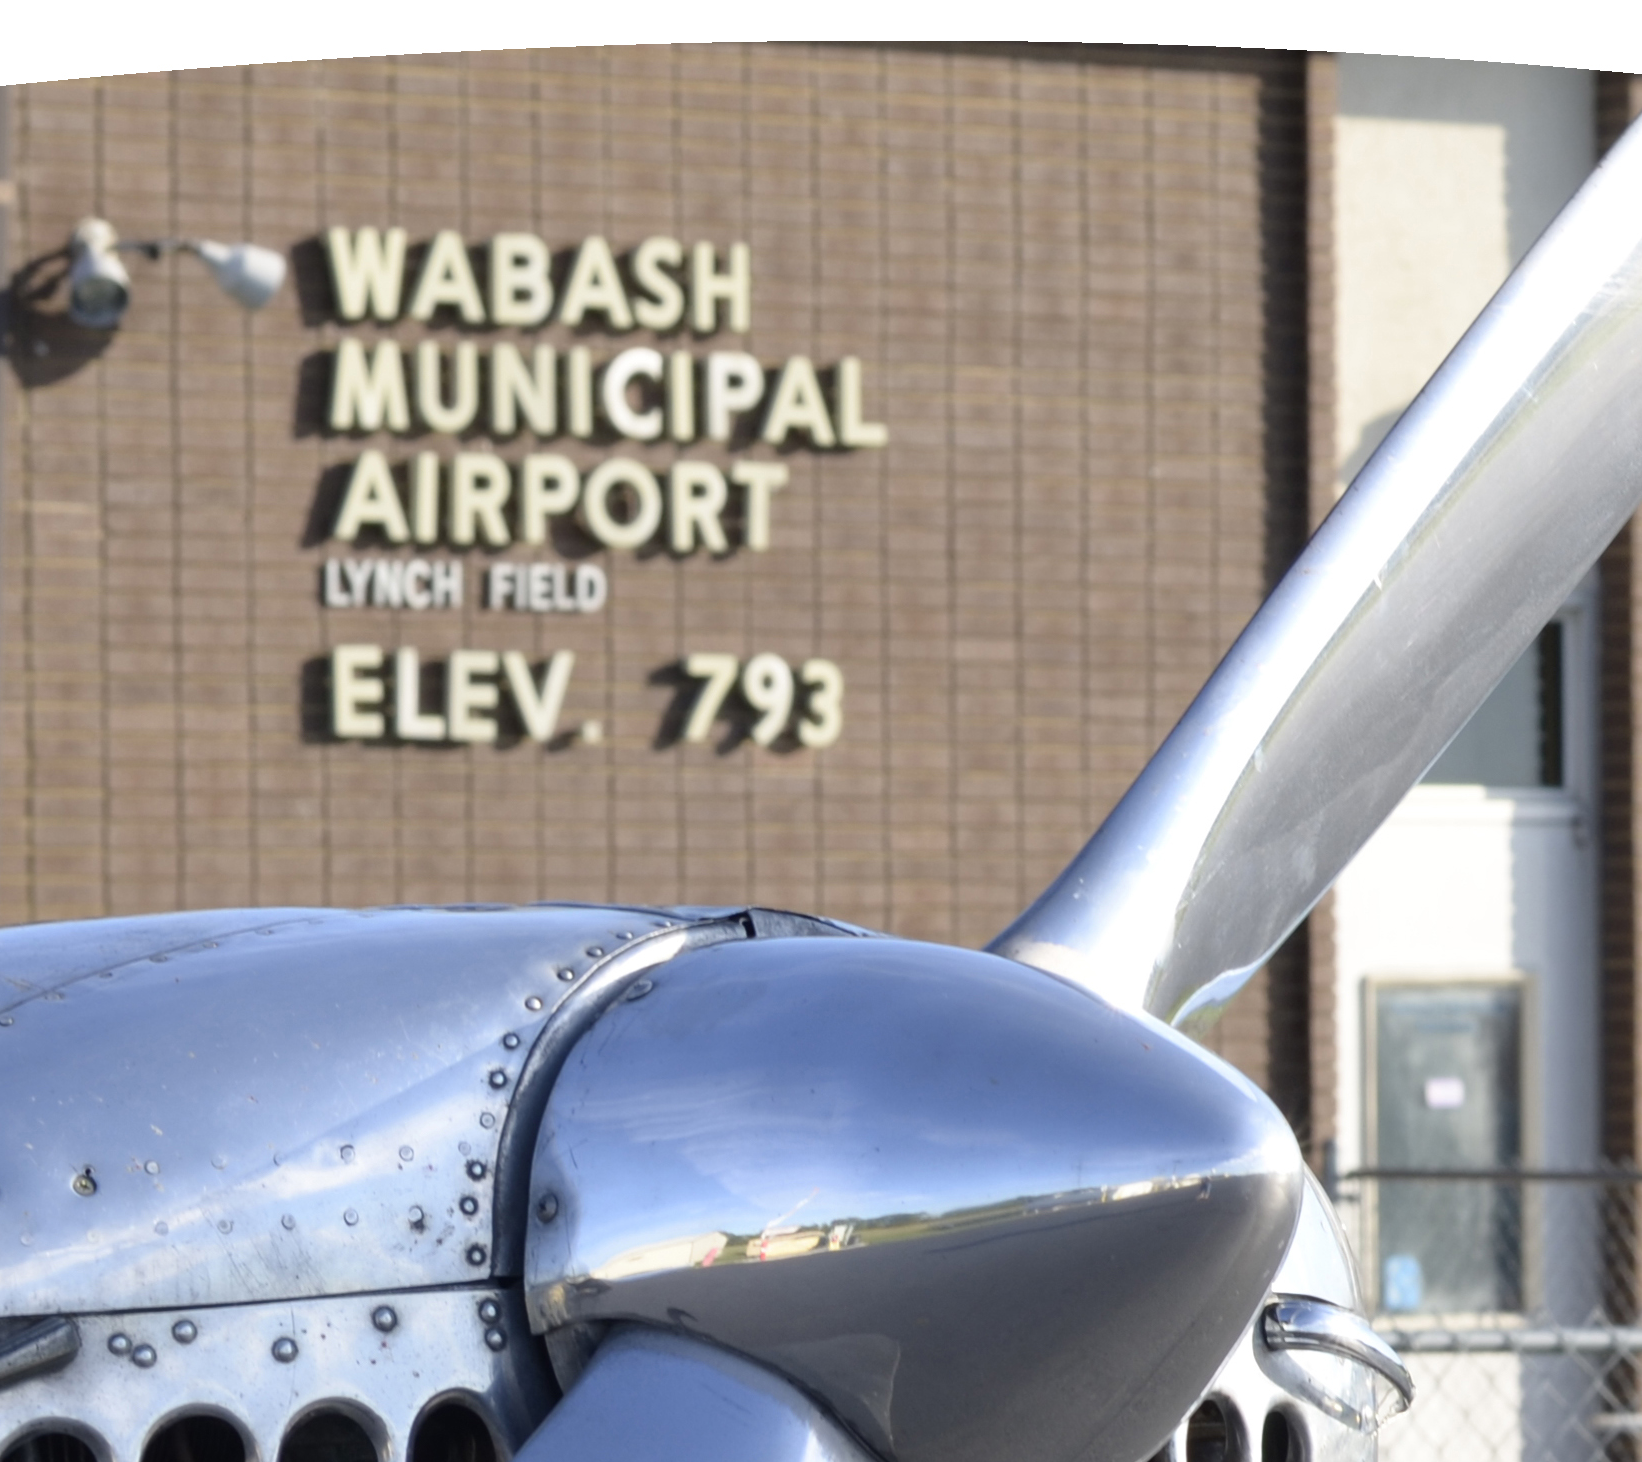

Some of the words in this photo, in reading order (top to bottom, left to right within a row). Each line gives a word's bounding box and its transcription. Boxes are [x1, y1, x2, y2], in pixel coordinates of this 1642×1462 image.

[328, 226, 751, 333] WABASH
[330, 338, 888, 448] MUNICIPAL
[334, 450, 789, 552] AIRPORT
[323, 559, 463, 609] LYNCH
[489, 563, 607, 613] FIELD
[332, 645, 603, 743] ELEV.
[685, 652, 844, 748] 793
